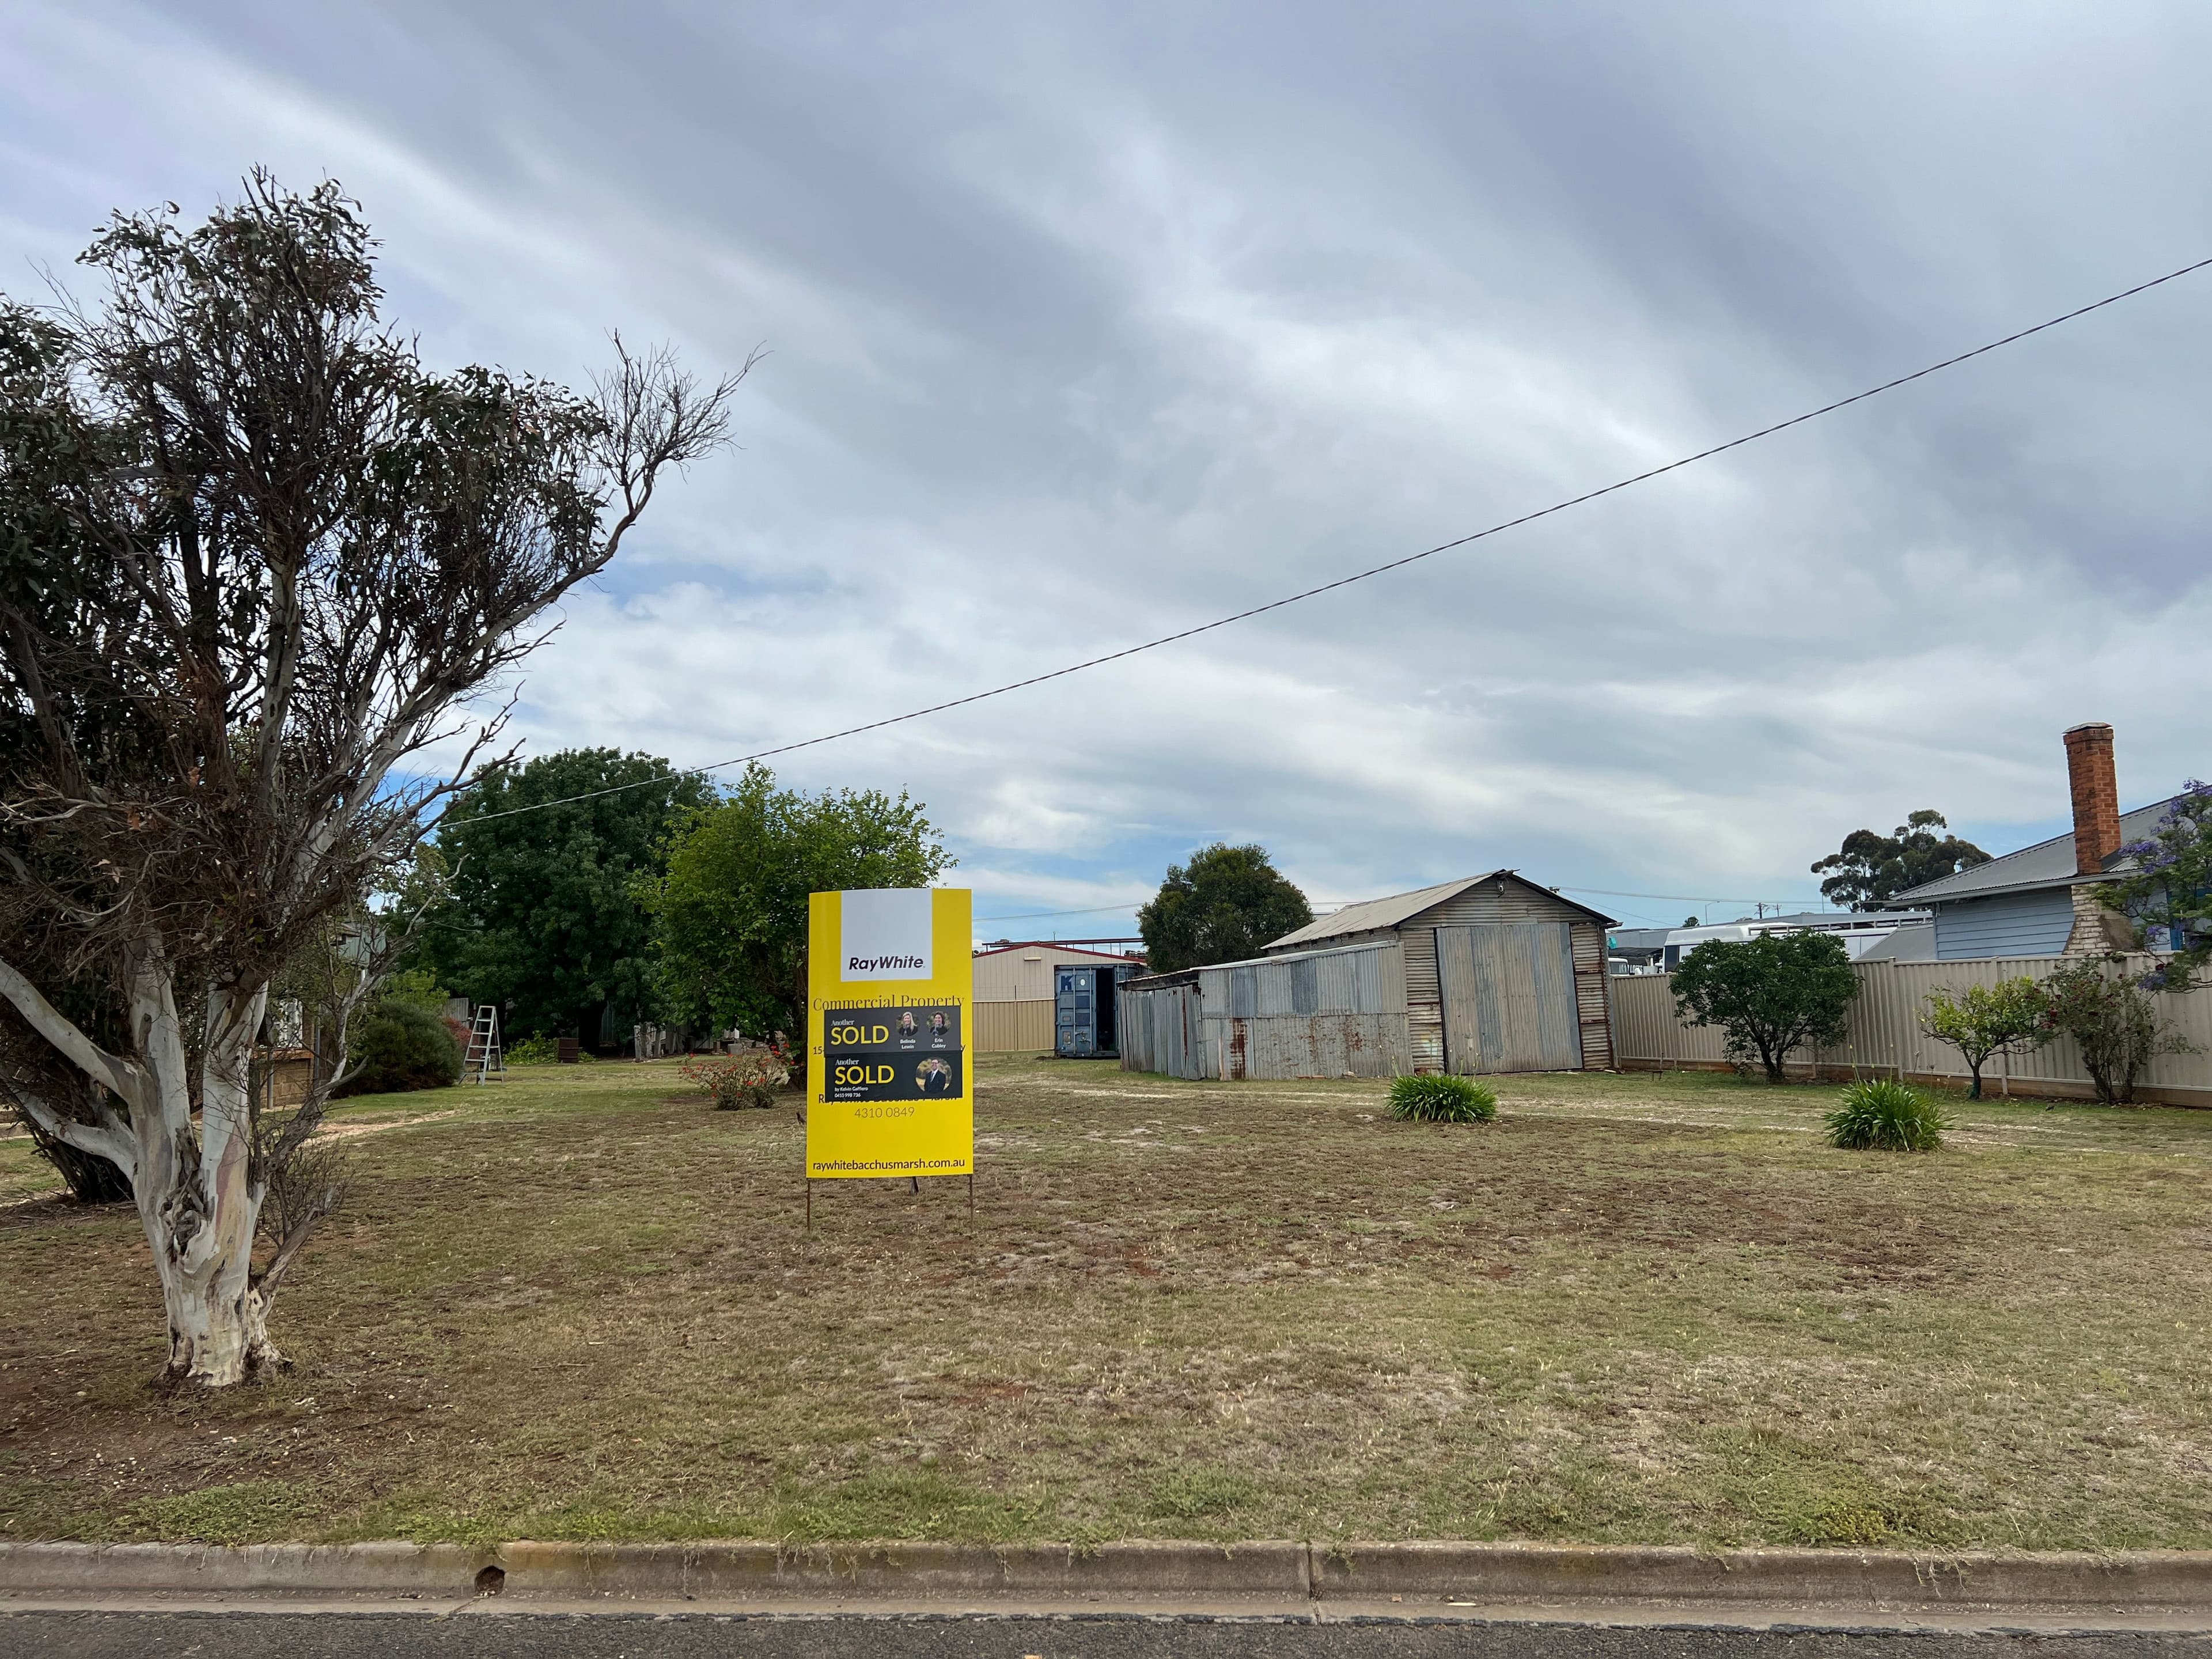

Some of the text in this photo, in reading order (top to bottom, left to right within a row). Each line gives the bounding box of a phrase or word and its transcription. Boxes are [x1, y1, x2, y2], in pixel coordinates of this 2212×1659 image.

[813, 994, 895, 1011] Commercial
[831, 1025, 889, 1046] SOLD
[835, 1065, 895, 1085] SOLD
[854, 1107, 915, 1119] 4310 0849
[813, 1158, 965, 1172] raywhitebacchusmarsh.com.au
